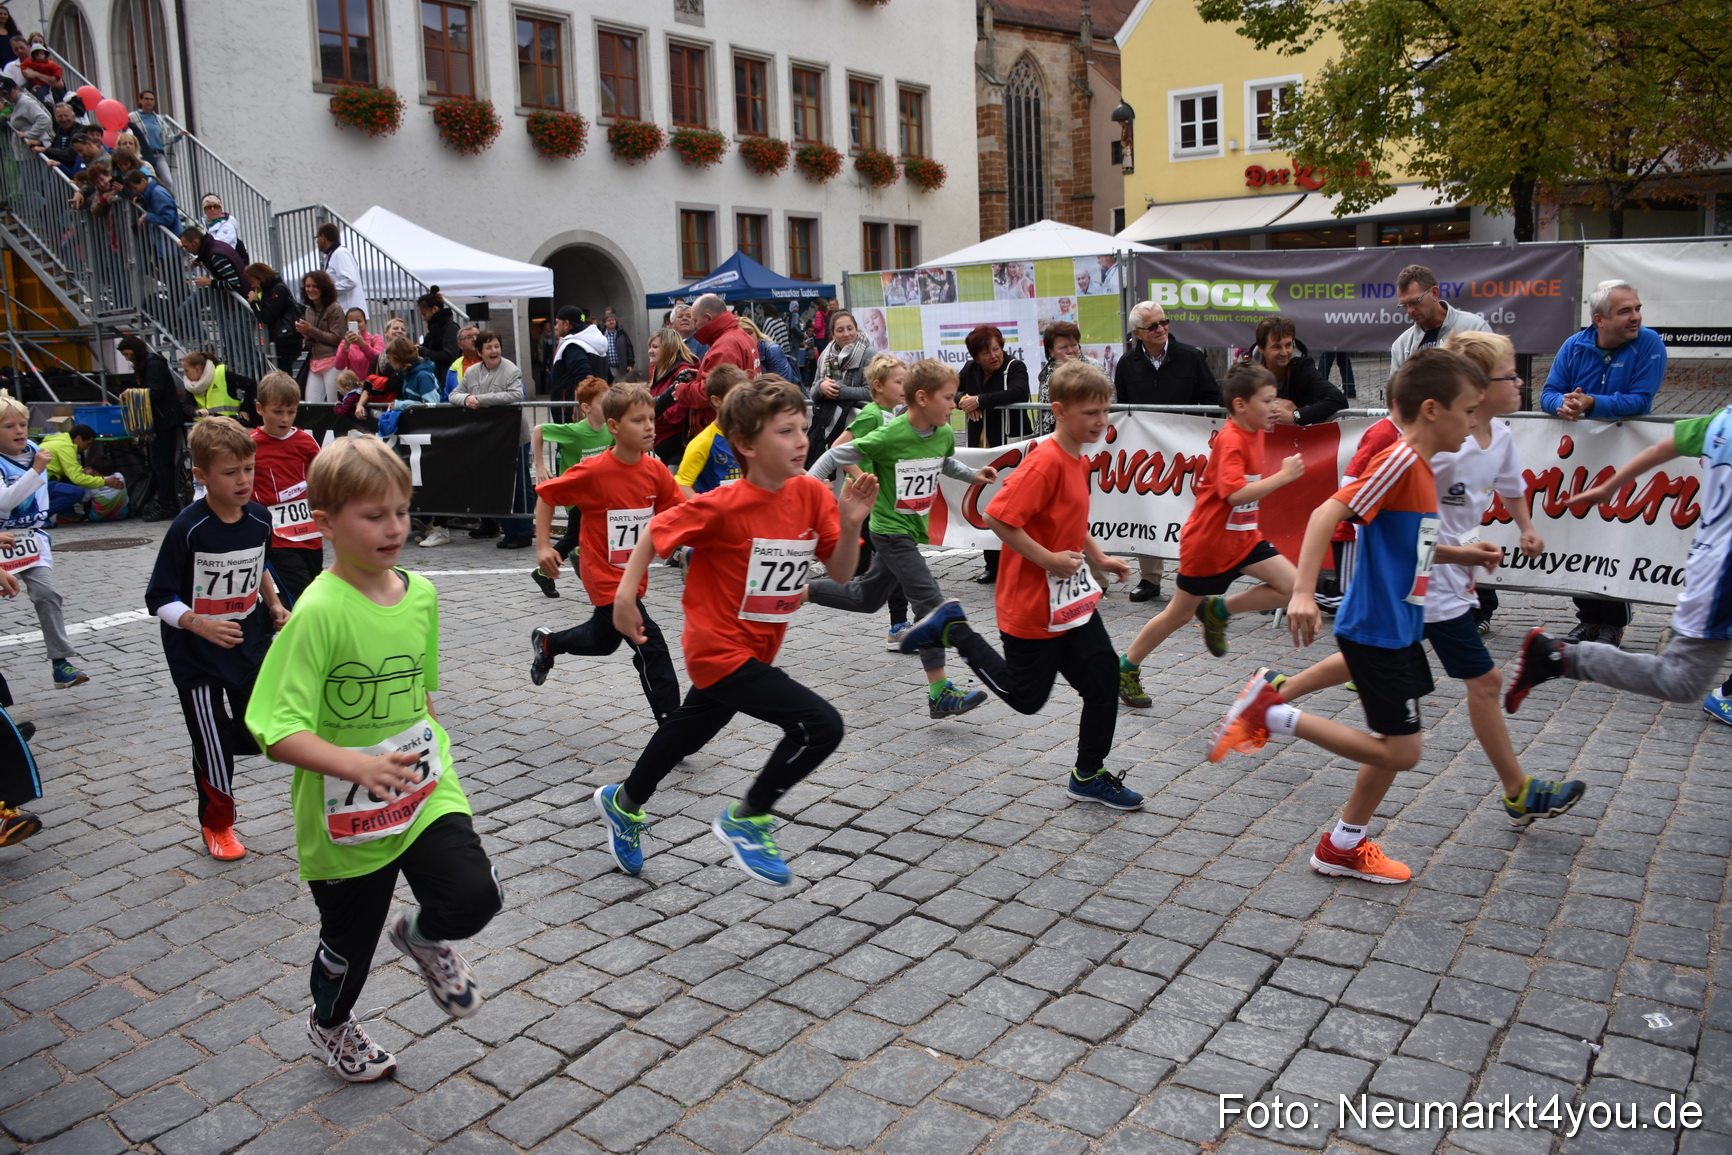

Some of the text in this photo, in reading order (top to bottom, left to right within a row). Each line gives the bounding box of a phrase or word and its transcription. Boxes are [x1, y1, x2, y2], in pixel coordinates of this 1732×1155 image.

[1245, 165, 1289, 187] Der
[1152, 283, 1273, 307] BOCK
[1289, 279, 1561, 300] OFFICE INDRY LOUNGE
[1189, 312, 1200, 323] by
[1204, 313, 1232, 322] smart
[1676, 332, 1731, 342] verbinden
[938, 350, 971, 363] Neue
[615, 524, 648, 547] 71
[753, 547, 784, 556] PARTL
[196, 559, 226, 567] PARTL
[203, 563, 258, 596] 7173
[225, 601, 245, 611] Tim
[1061, 600, 1096, 622] Sebastian
[351, 793, 427, 834] Ferdinan
